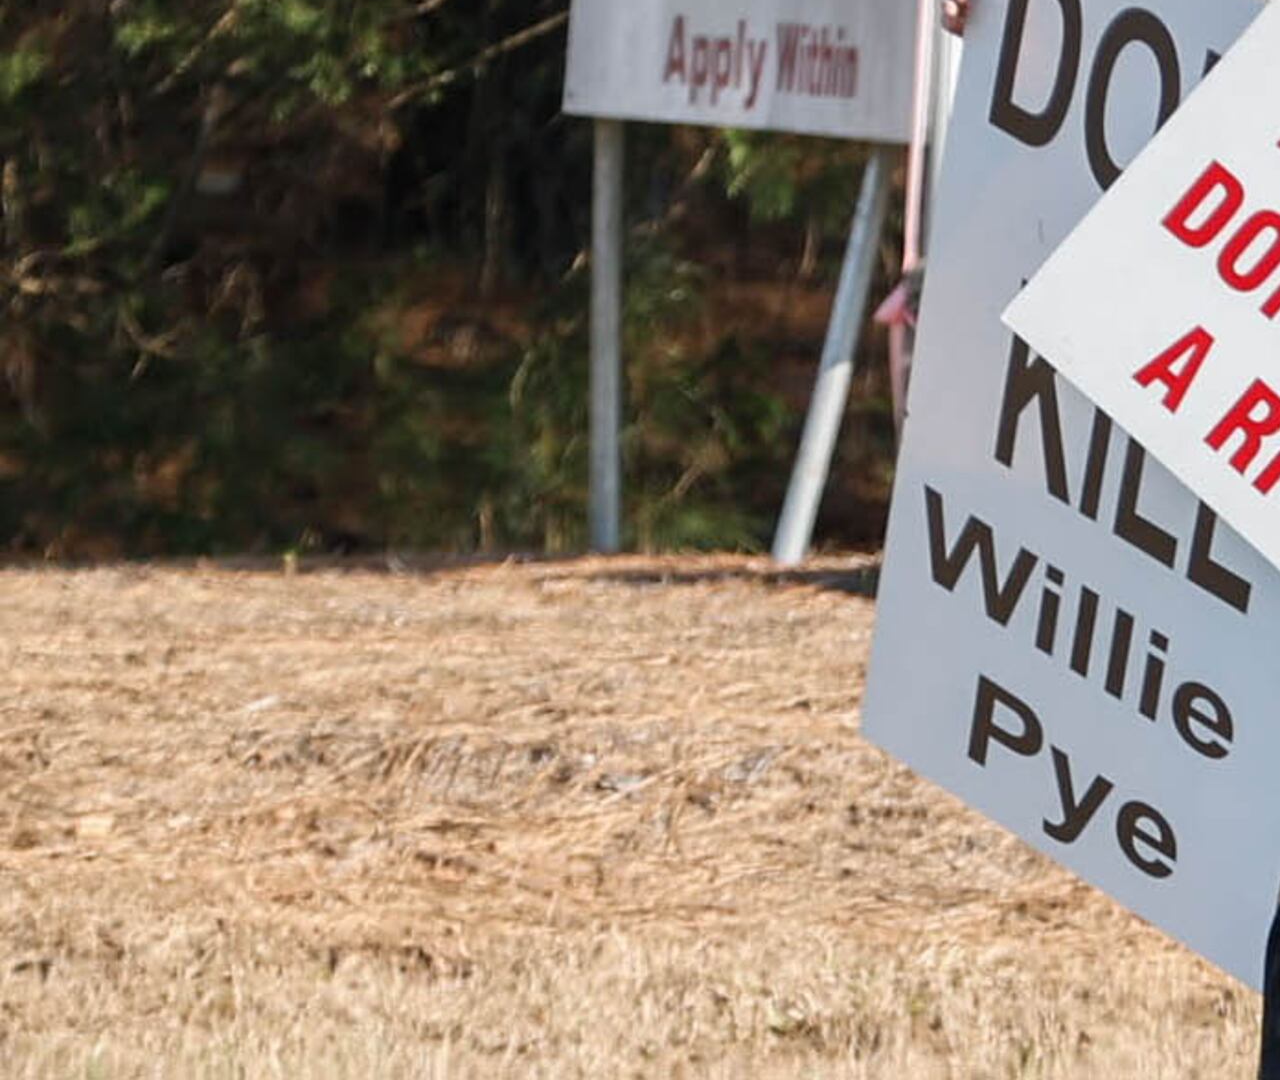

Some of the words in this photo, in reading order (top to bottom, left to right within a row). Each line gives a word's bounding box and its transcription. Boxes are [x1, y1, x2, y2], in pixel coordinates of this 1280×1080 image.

[663, 14, 766, 109] Apply
[776, 23, 858, 98] Within
[1132, 325, 1214, 414] A
[924, 484, 1234, 760] Willie
[966, 674, 1178, 879] Pye
